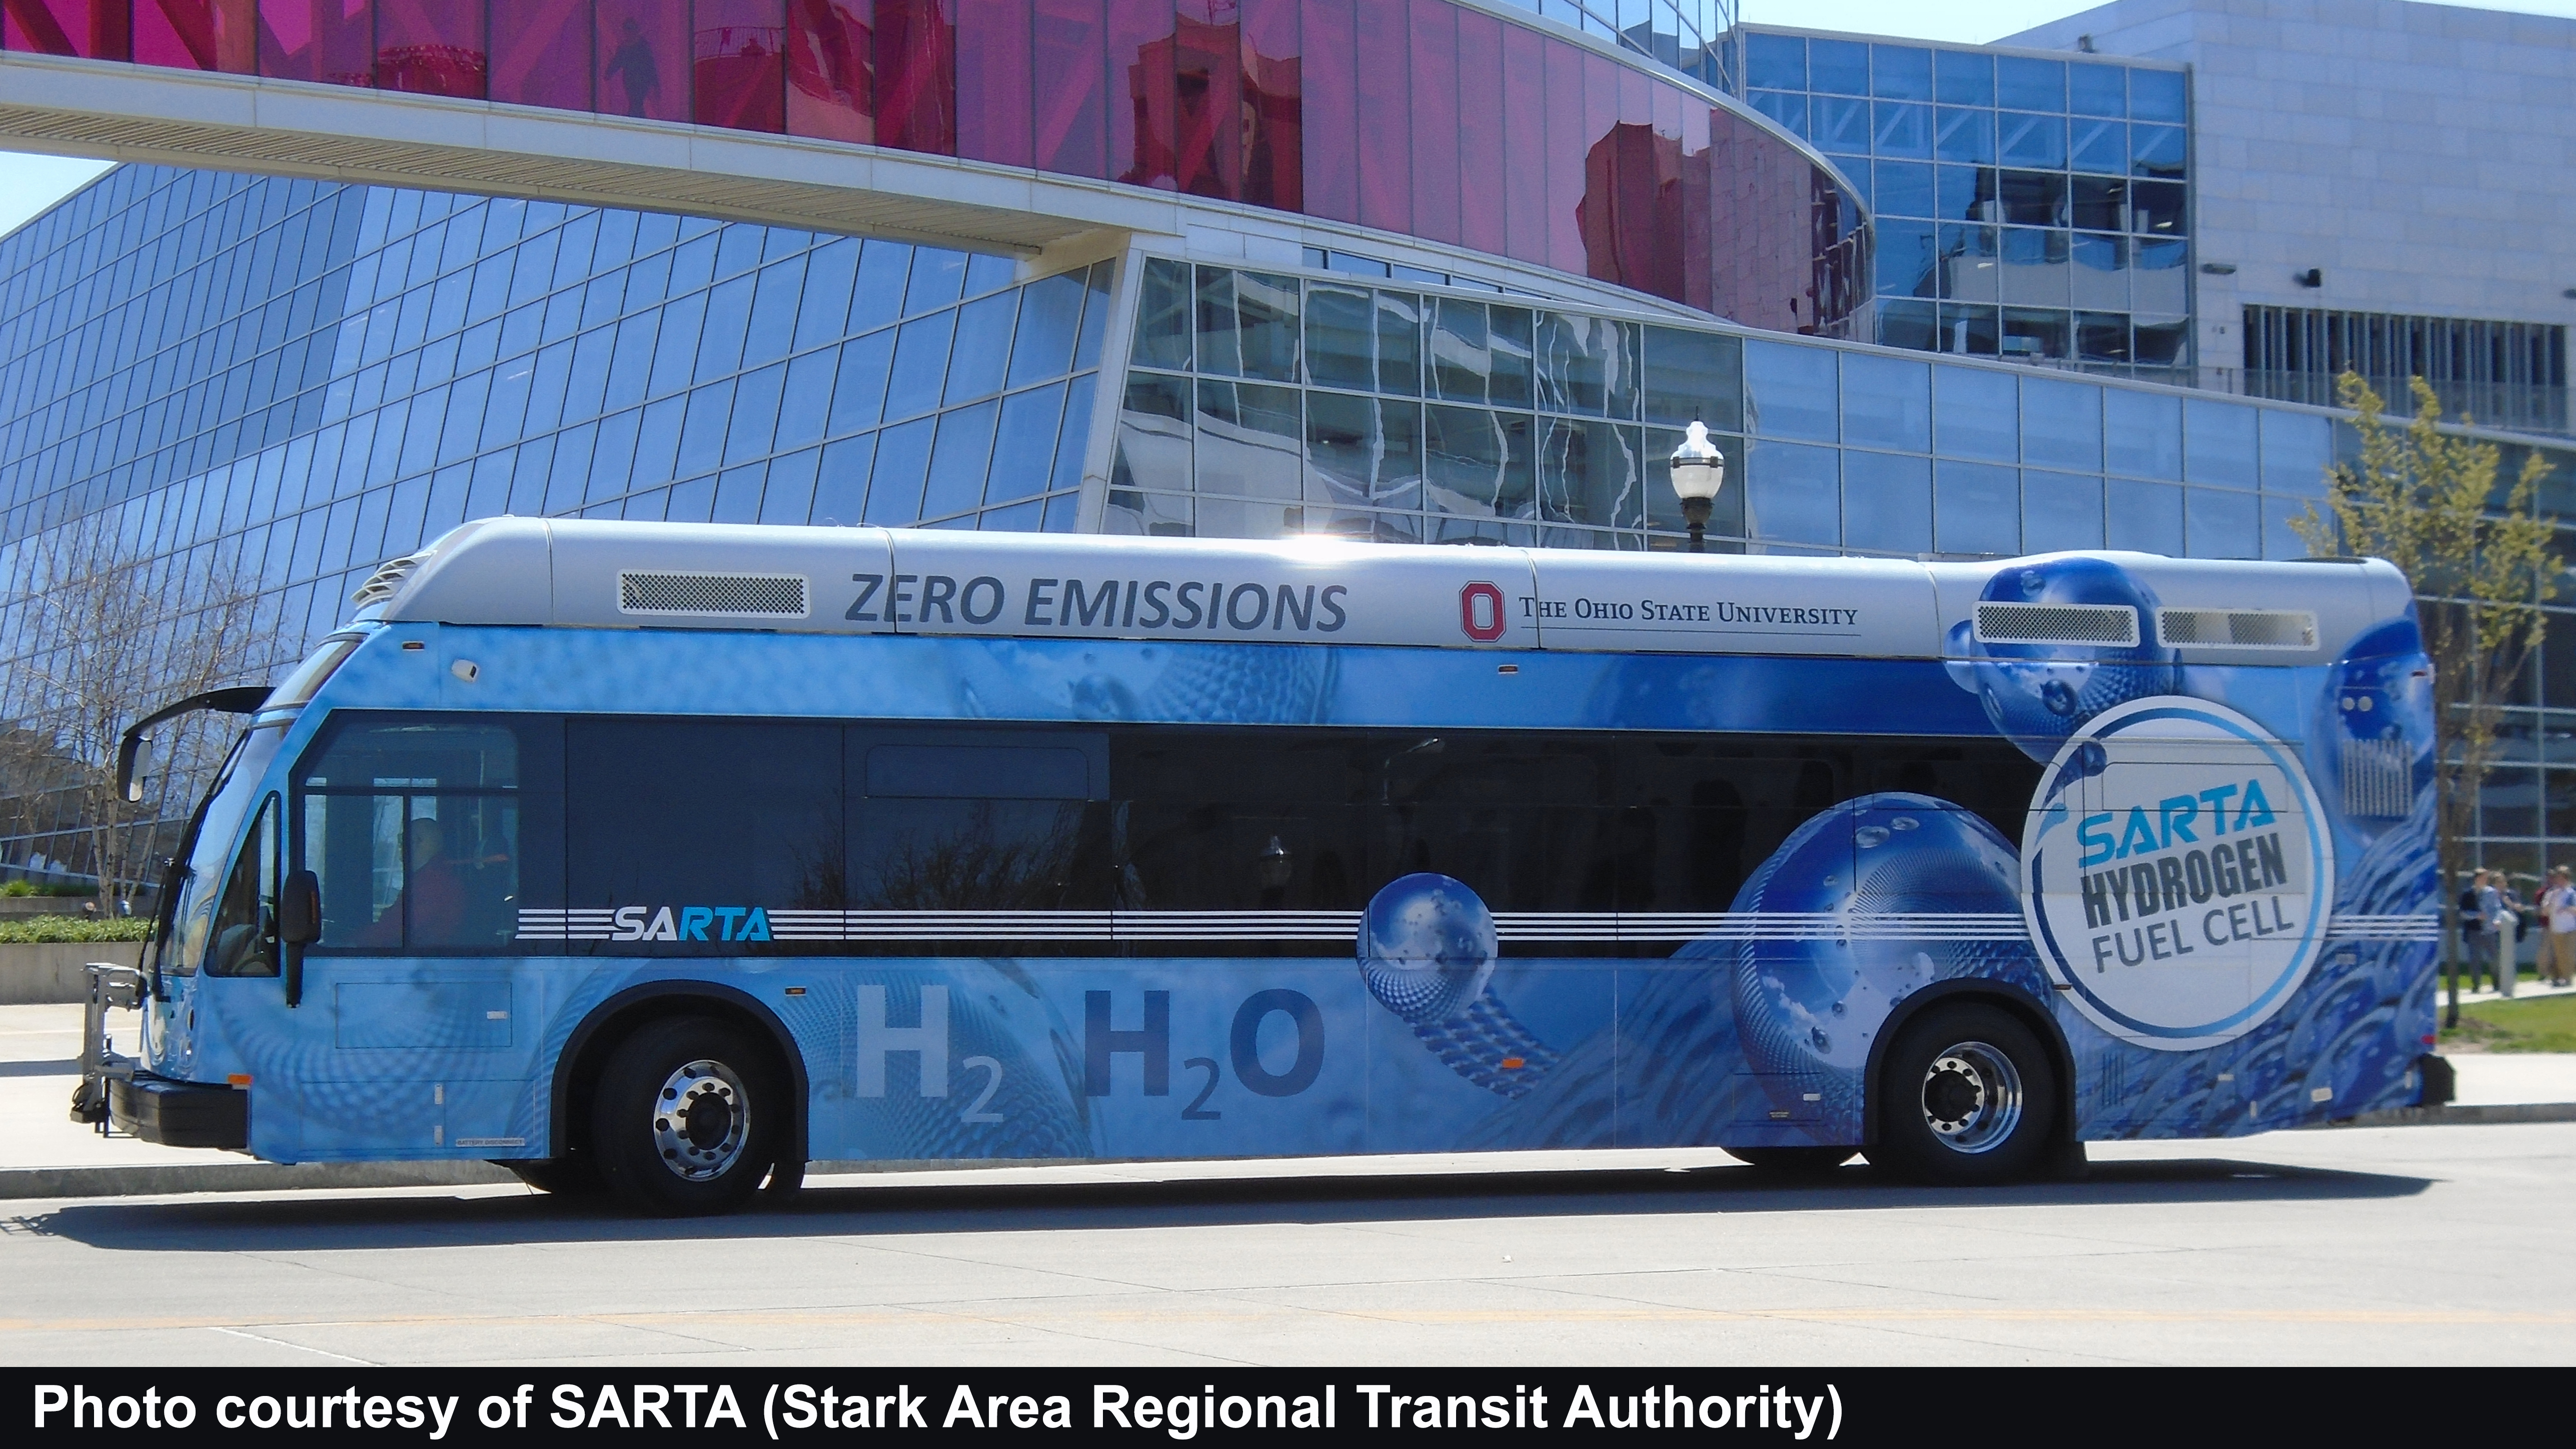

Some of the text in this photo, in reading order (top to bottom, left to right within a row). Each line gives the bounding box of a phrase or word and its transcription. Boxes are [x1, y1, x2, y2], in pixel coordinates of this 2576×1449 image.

[845, 574, 1347, 632] ZERO EMISSIONS
[2076, 779, 2277, 868] SARTA
[2080, 833, 2288, 929] HYDROGEN
[611, 906, 770, 941] SARTA
[2092, 895, 2295, 974] FUEL CELL
